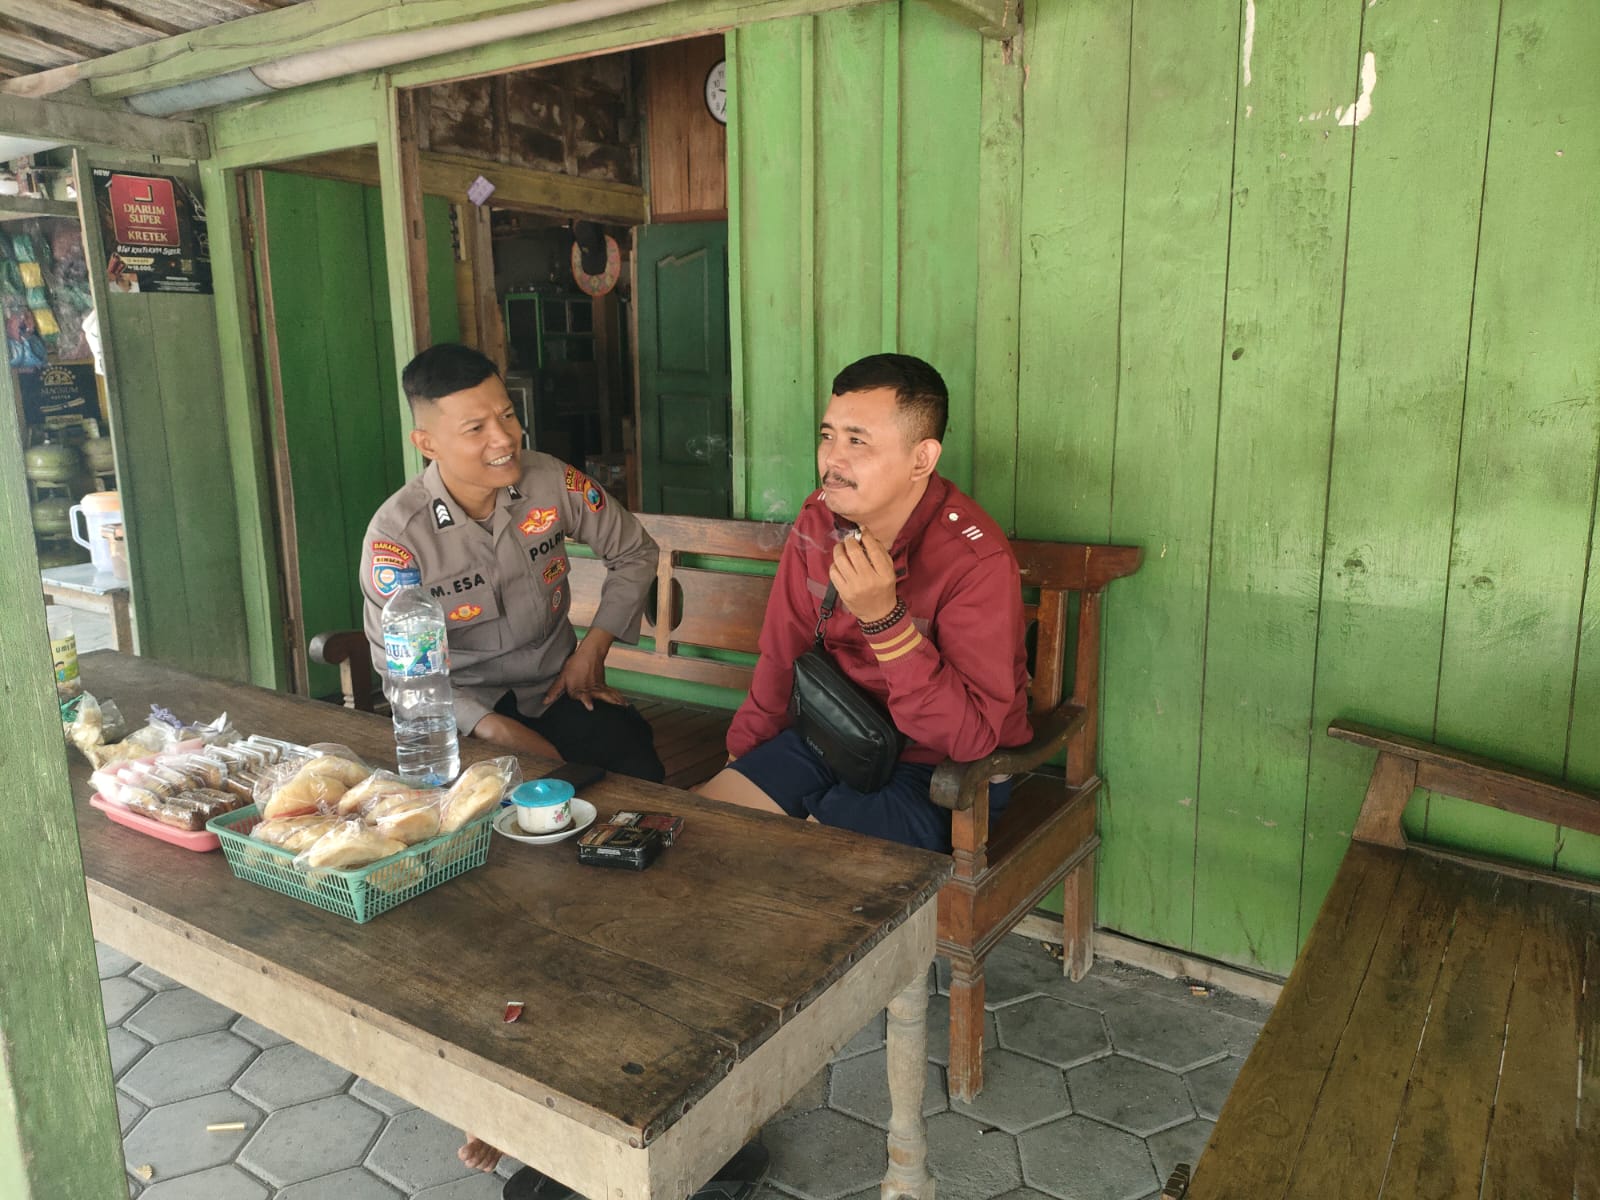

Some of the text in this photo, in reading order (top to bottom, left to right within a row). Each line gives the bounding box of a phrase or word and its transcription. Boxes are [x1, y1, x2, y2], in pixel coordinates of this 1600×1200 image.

[93, 169, 110, 177] NEW
[123, 203, 165, 215] DJARUM
[129, 214, 162, 225] SUPER
[127, 230, 168, 242] KRETEK
[430, 573, 485, 597] M. ESA
